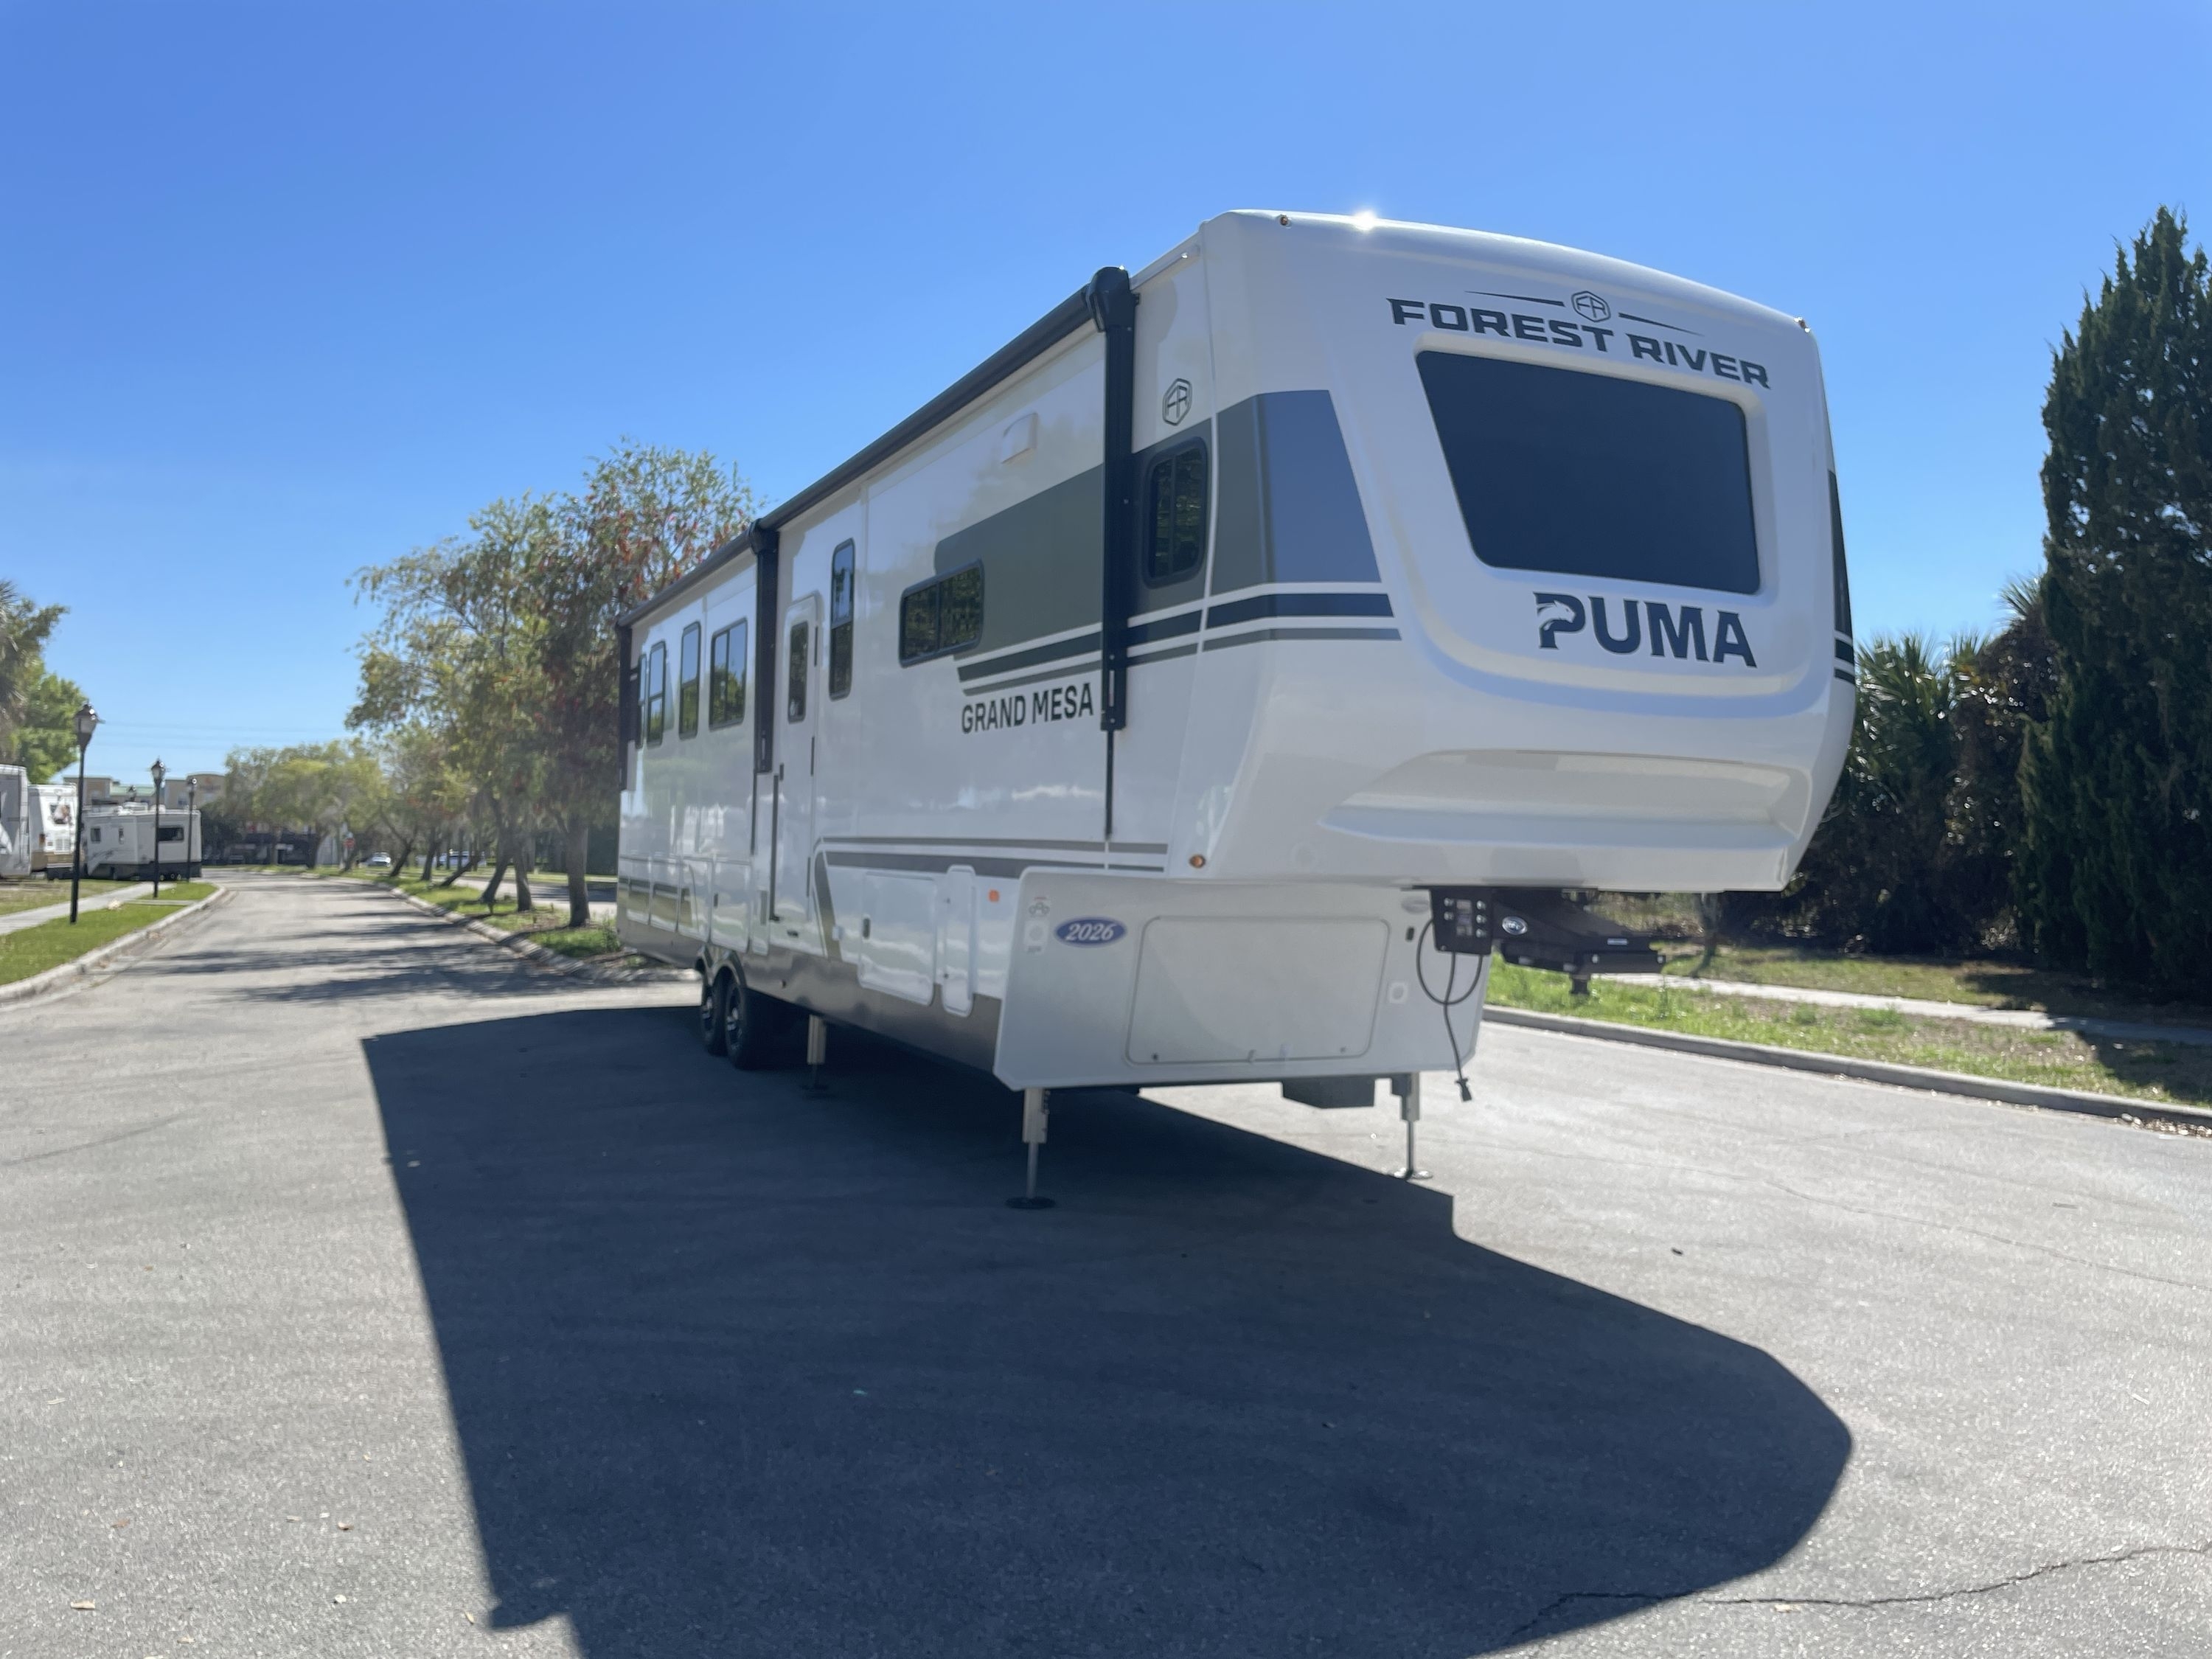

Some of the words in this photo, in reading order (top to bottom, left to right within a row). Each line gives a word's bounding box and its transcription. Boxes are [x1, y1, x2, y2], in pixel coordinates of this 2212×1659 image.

[1386, 298, 1613, 352] FOREST
[1625, 333, 1771, 390] RIVER
[1533, 592, 1757, 668] PUMA
[961, 695, 1026, 734] GRAND
[1032, 683, 1093, 724] MESA
[1065, 923, 1116, 941] 2026
